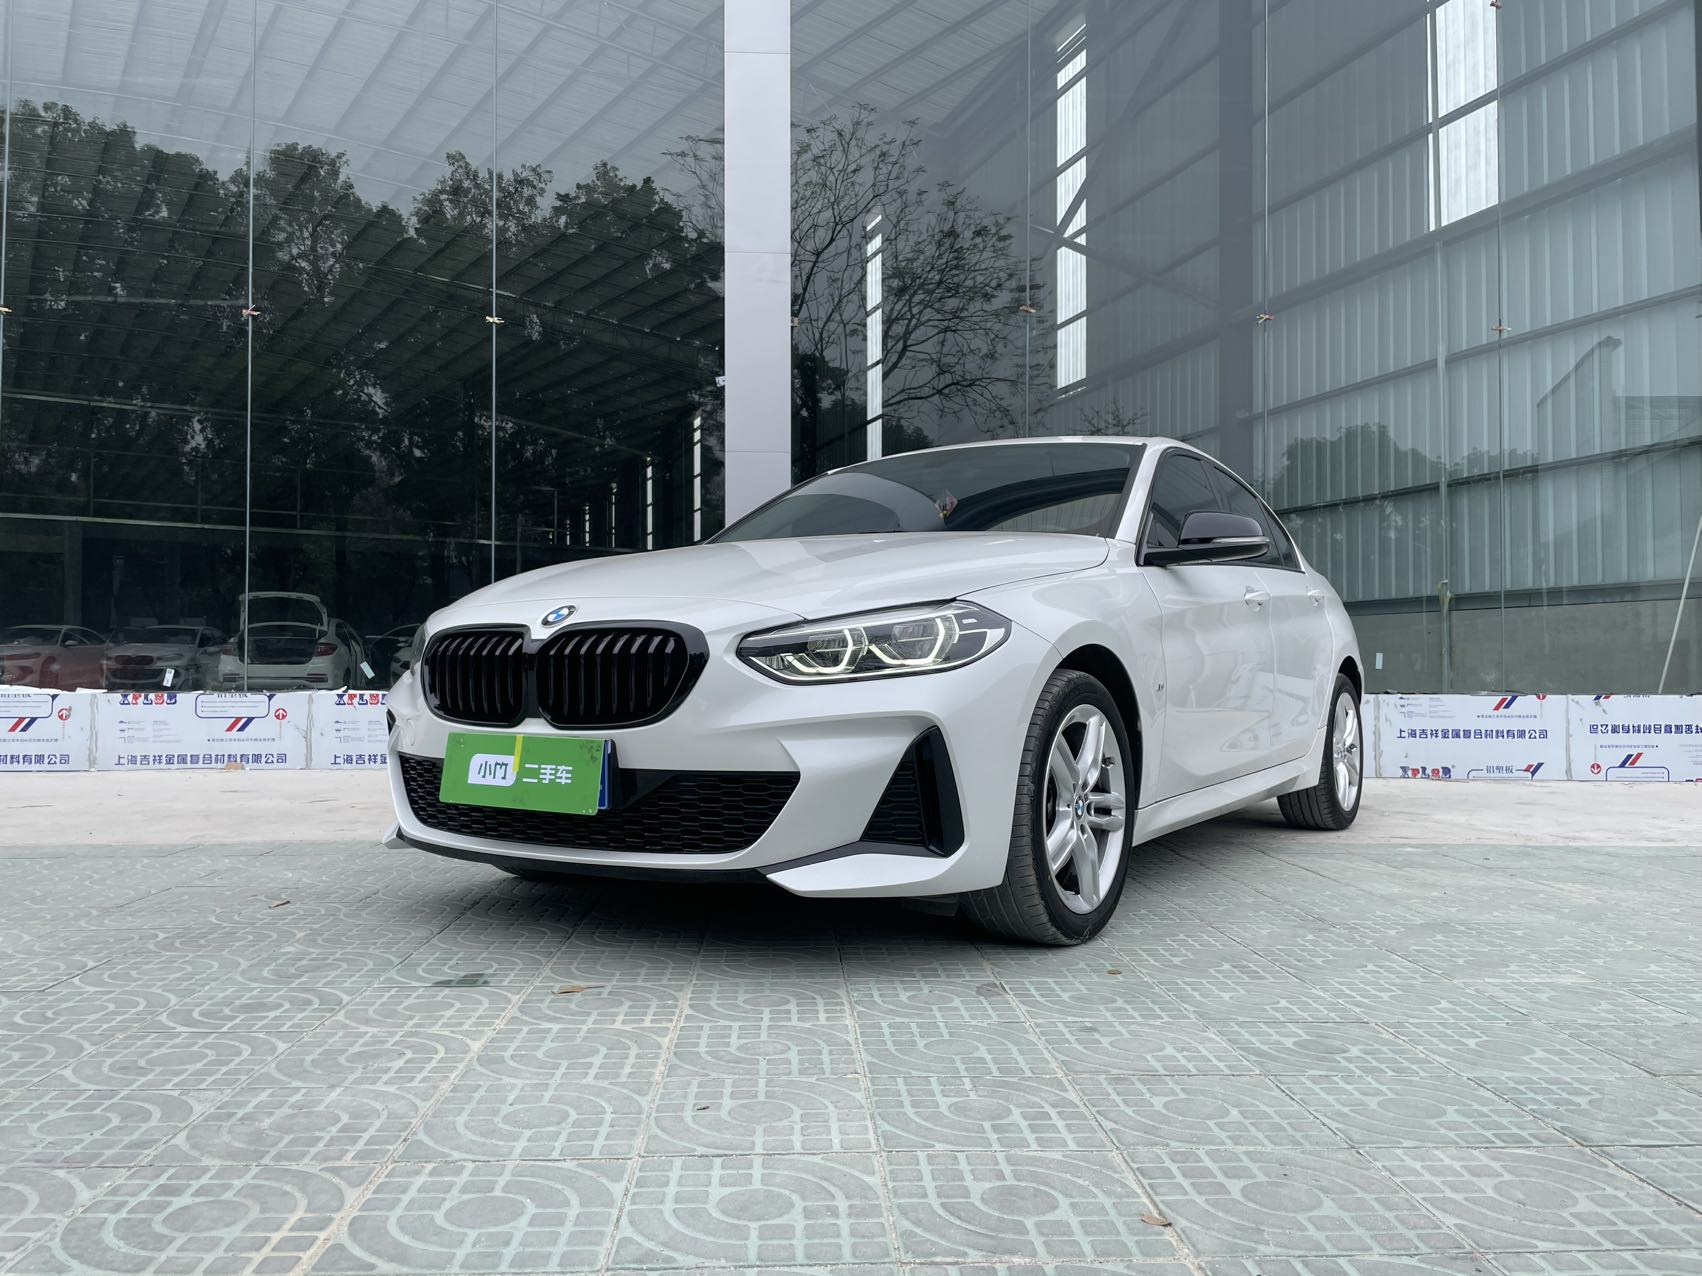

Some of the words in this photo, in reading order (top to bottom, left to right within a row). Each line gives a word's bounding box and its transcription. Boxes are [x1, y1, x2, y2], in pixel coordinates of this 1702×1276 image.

[1397, 728, 1548, 739] 上海吉祥金属复合材料有限公司
[115, 753, 287, 766] 上海吉祥金属复合材料有限公司
[522, 763, 573, 785] 二手车
